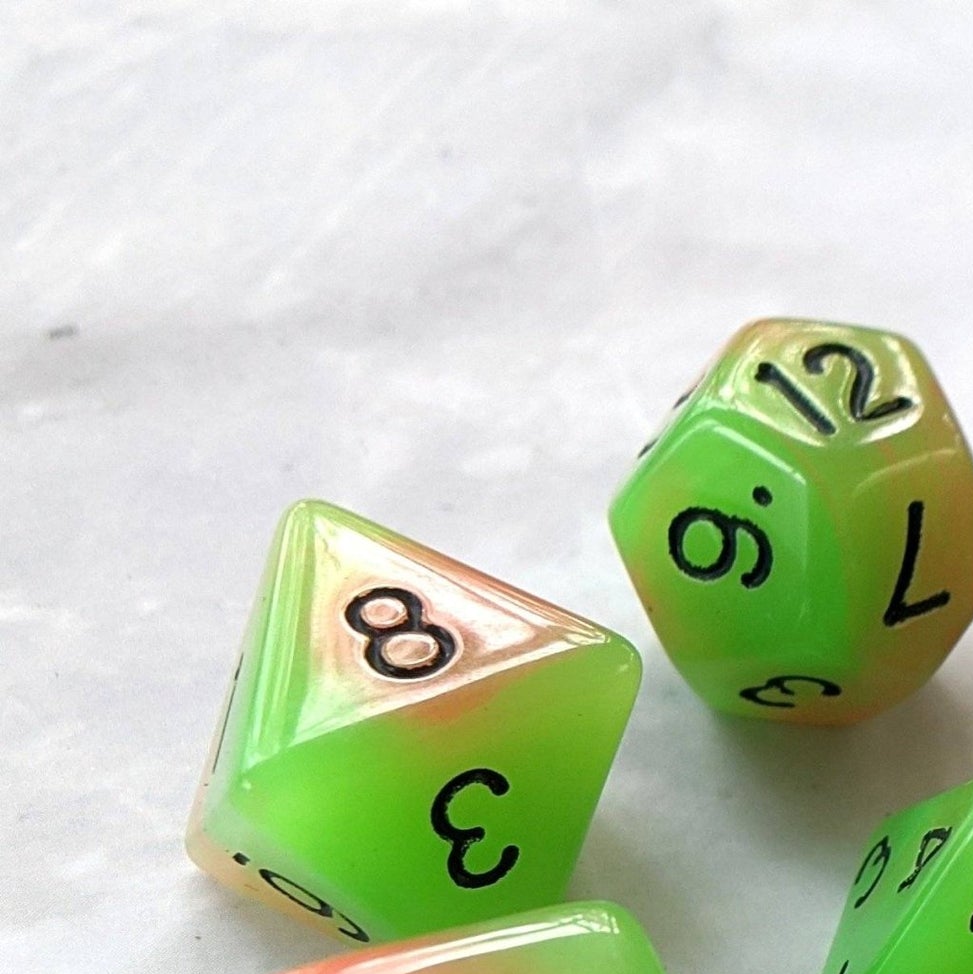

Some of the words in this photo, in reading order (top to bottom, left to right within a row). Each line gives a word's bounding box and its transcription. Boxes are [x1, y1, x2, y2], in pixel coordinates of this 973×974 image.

[756, 343, 914, 435] 12
[883, 501, 950, 627] 7
[345, 587, 456, 679] 8
[740, 676, 842, 708] 3
[431, 769, 519, 889] 3
